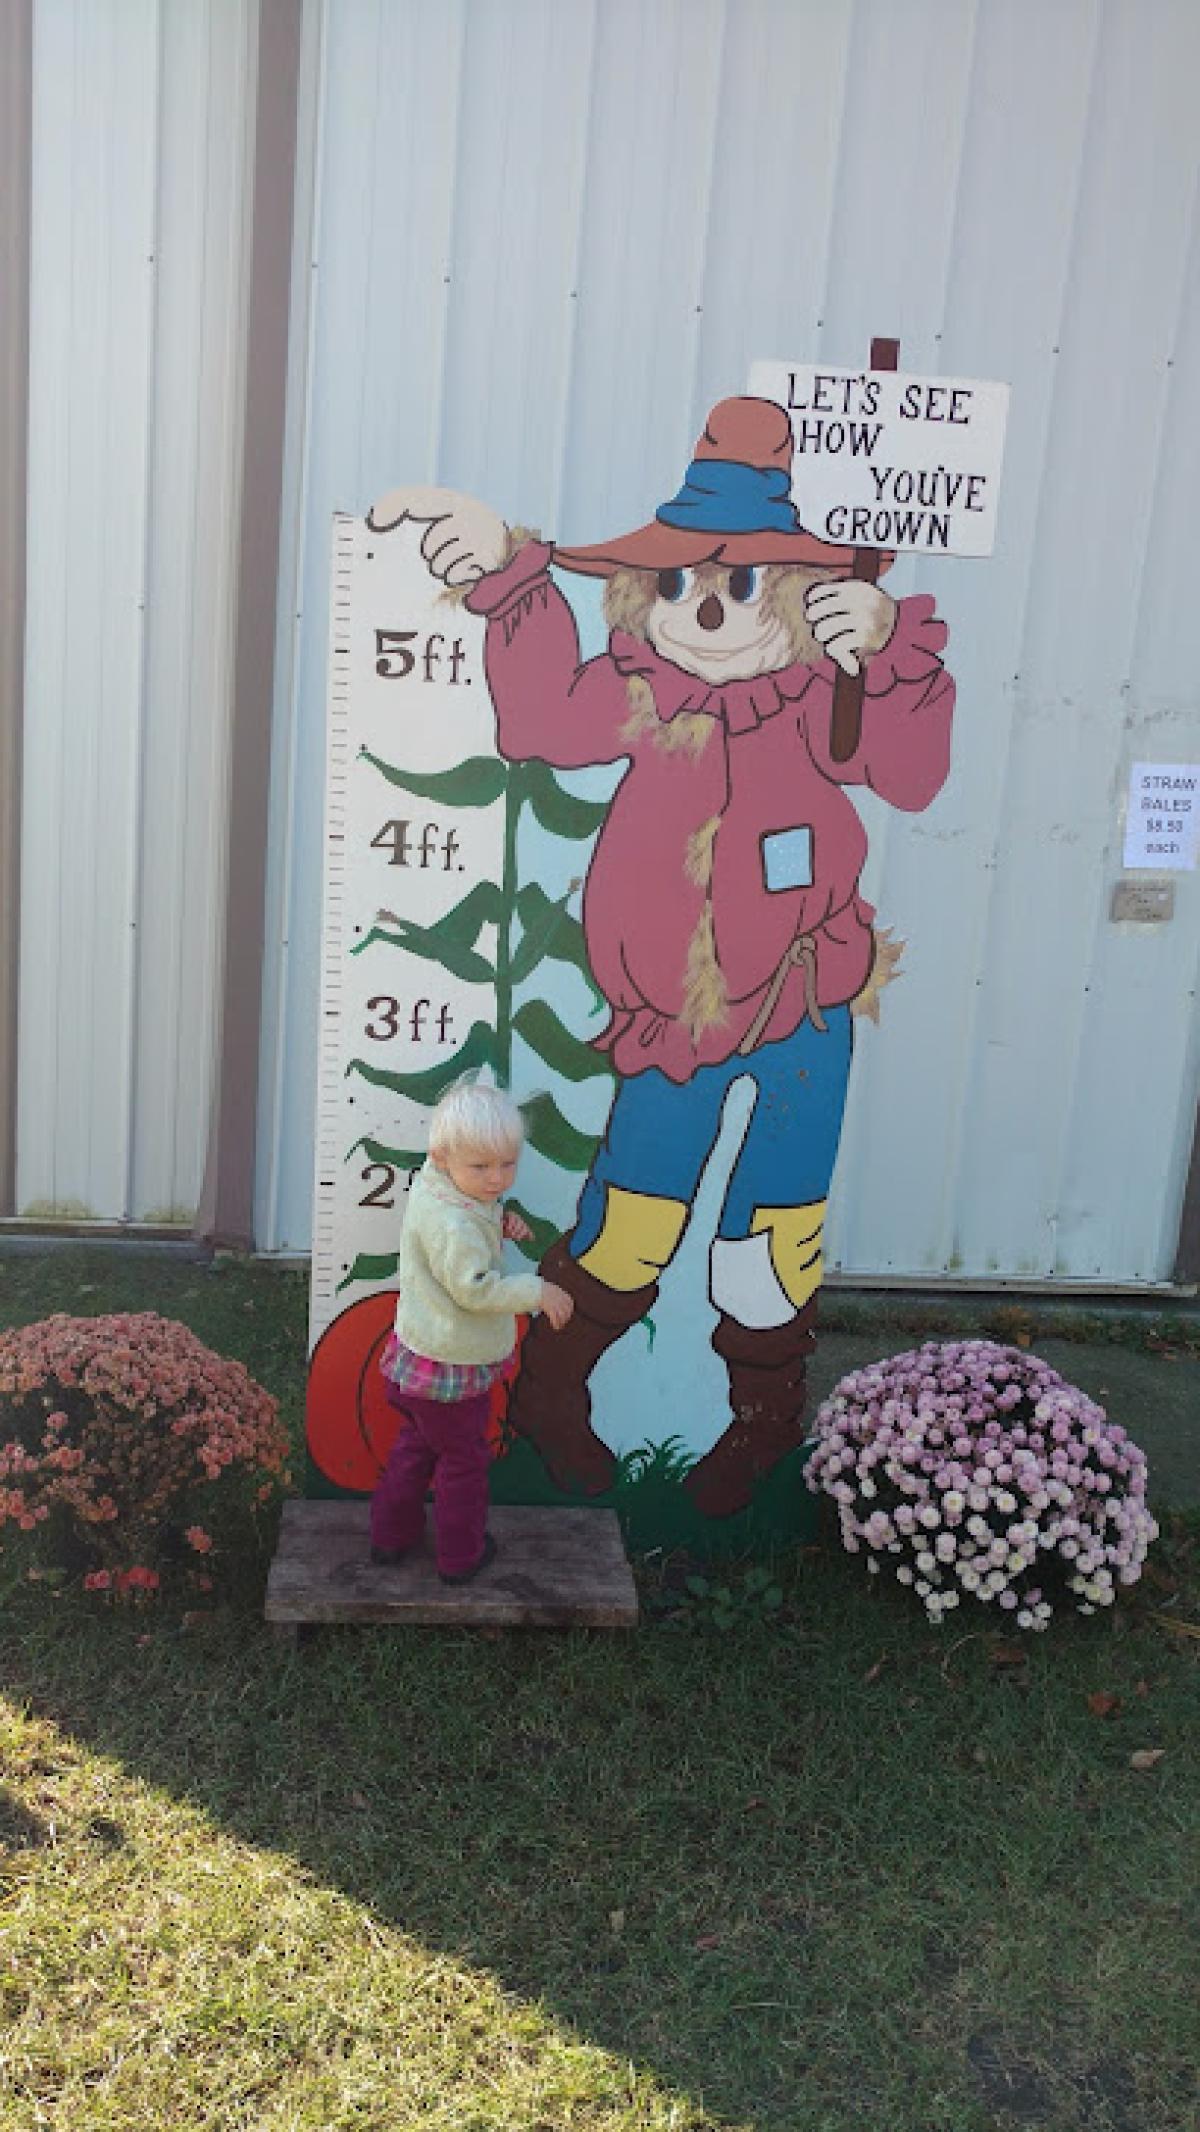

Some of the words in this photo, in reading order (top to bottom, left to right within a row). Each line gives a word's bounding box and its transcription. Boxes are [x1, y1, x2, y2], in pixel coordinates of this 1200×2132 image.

[787, 373, 882, 415] LET'S
[900, 384, 973, 424] SEE
[797, 419, 884, 457] HOW
[869, 465, 986, 512] YOU'VE
[825, 505, 951, 547] GROWN
[1140, 776, 1197, 791] STRAW
[1140, 797, 1192, 812] BALES
[1145, 840, 1181, 854] each
